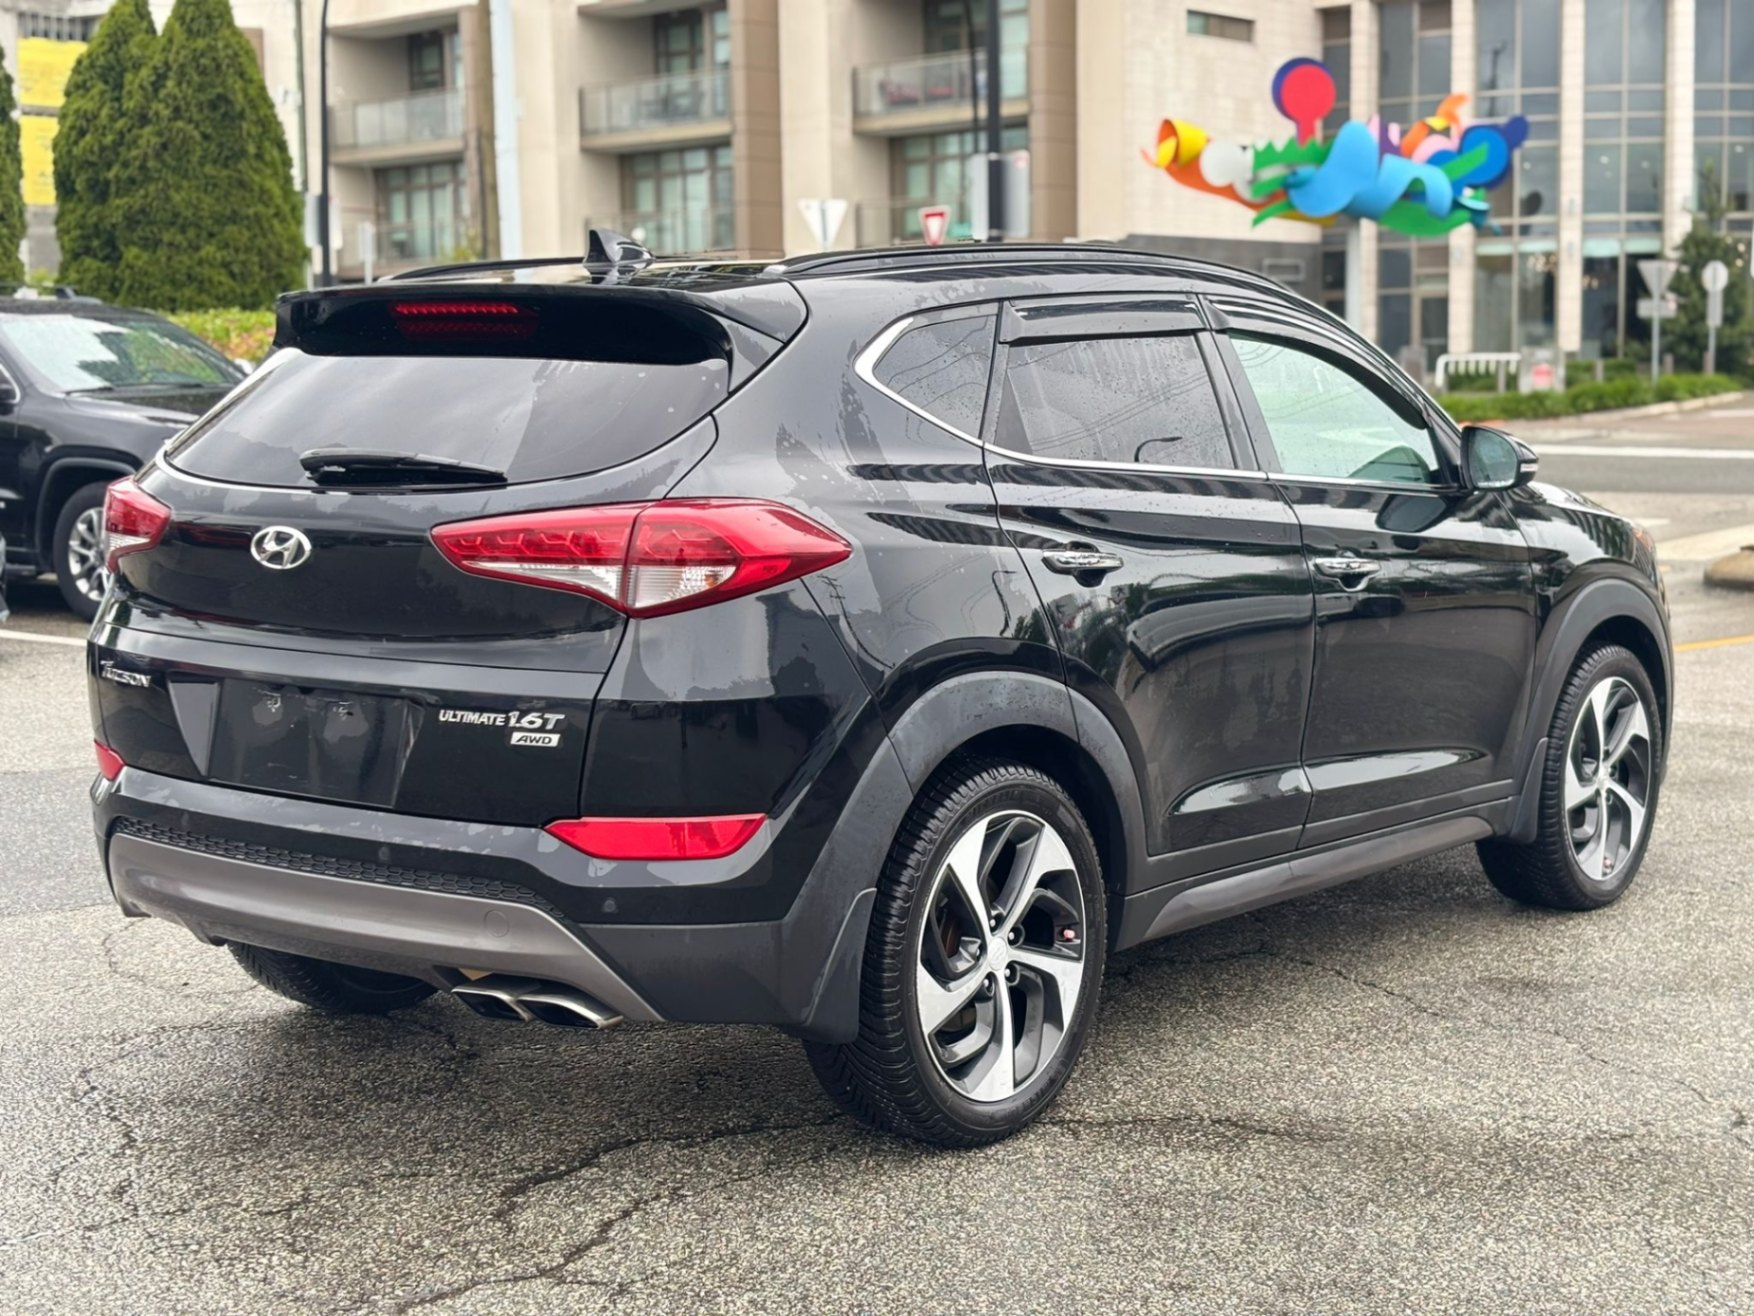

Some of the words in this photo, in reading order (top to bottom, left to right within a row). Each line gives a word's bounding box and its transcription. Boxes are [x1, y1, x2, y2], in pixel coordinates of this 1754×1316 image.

[438, 709, 506, 726] ULTIMATE
[508, 710, 565, 730] 1.6T
[515, 734, 552, 745] AWD
